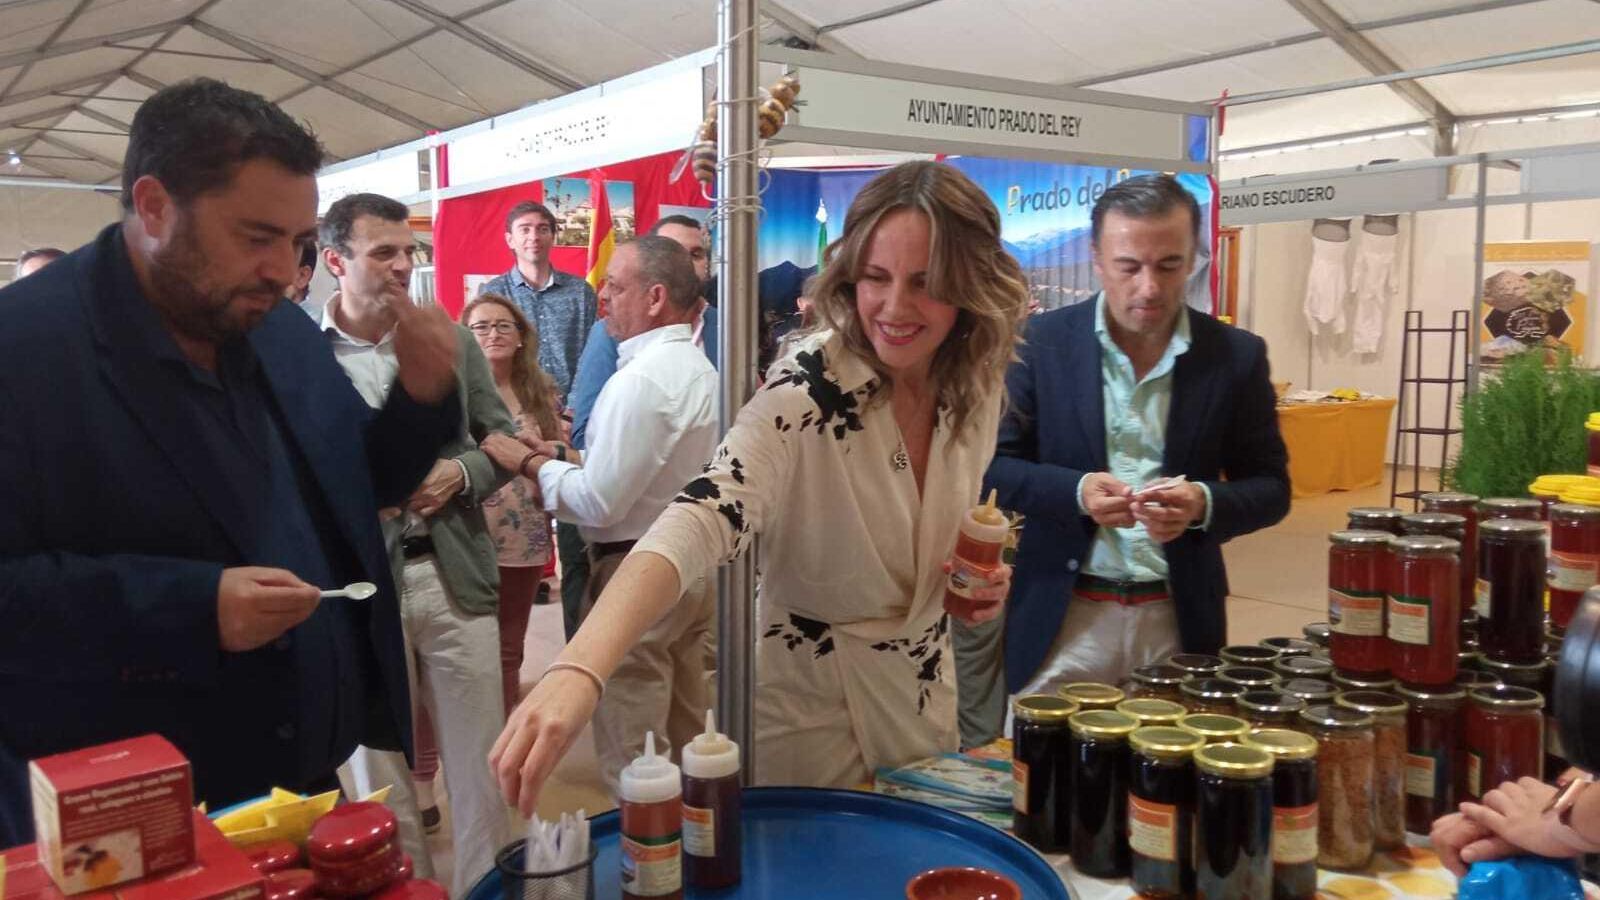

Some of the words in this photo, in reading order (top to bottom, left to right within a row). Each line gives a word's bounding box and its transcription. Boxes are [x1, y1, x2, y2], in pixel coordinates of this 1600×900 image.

[907, 99, 996, 130] AYUNTAMIENTO
[999, 108, 1037, 134] PRADO
[1039, 113, 1059, 136] DEL
[1061, 115, 1082, 138] REY
[1009, 180, 1071, 214] Prado
[1077, 169, 1111, 206] del
[1219, 193, 1259, 210] RIANO
[1264, 186, 1335, 206] ESCUDERO
